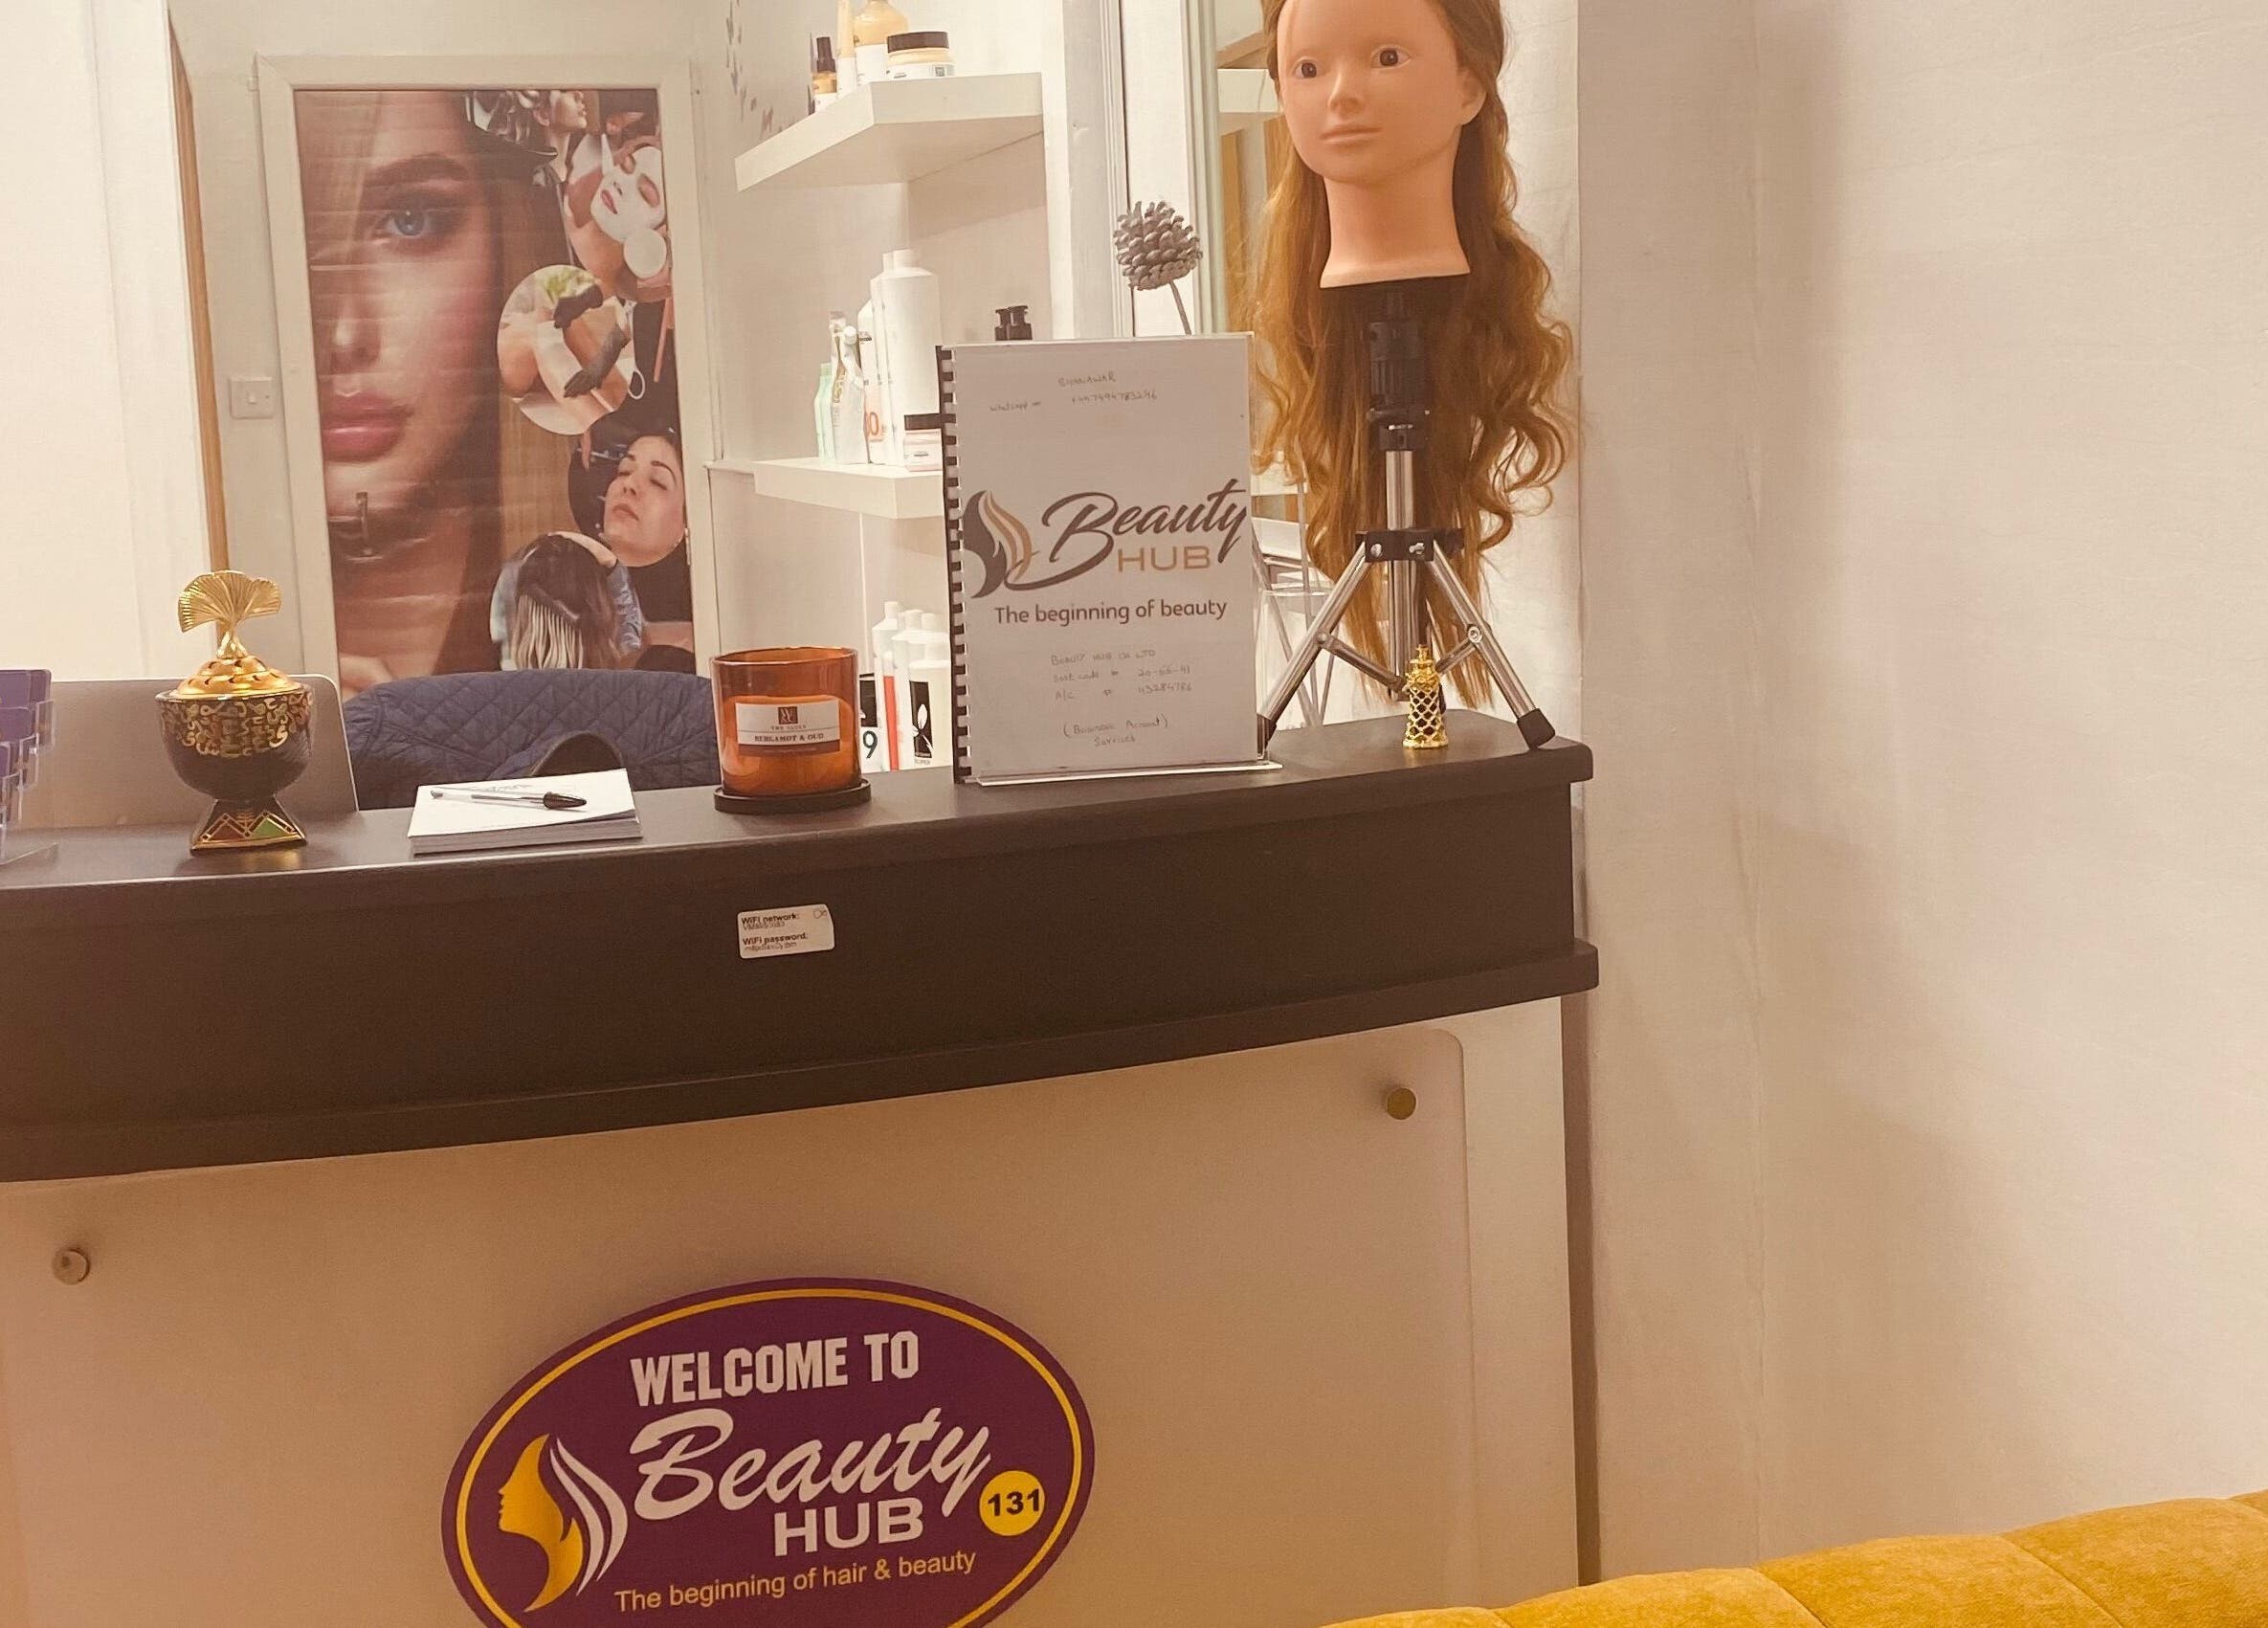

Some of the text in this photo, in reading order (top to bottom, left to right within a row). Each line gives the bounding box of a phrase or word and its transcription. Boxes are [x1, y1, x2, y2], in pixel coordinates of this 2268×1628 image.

[1004, 479, 1247, 591] Beauty
[1117, 546, 1212, 572] HUB
[994, 598, 1228, 627] The beginning of beauty
[630, 1330, 920, 1407] WELCOME TO
[629, 1407, 991, 1520] Beauty
[773, 1497, 924, 1557] HUB
[988, 1488, 1041, 1517] 131
[614, 1550, 976, 1613] The beginning of hair & beauty
